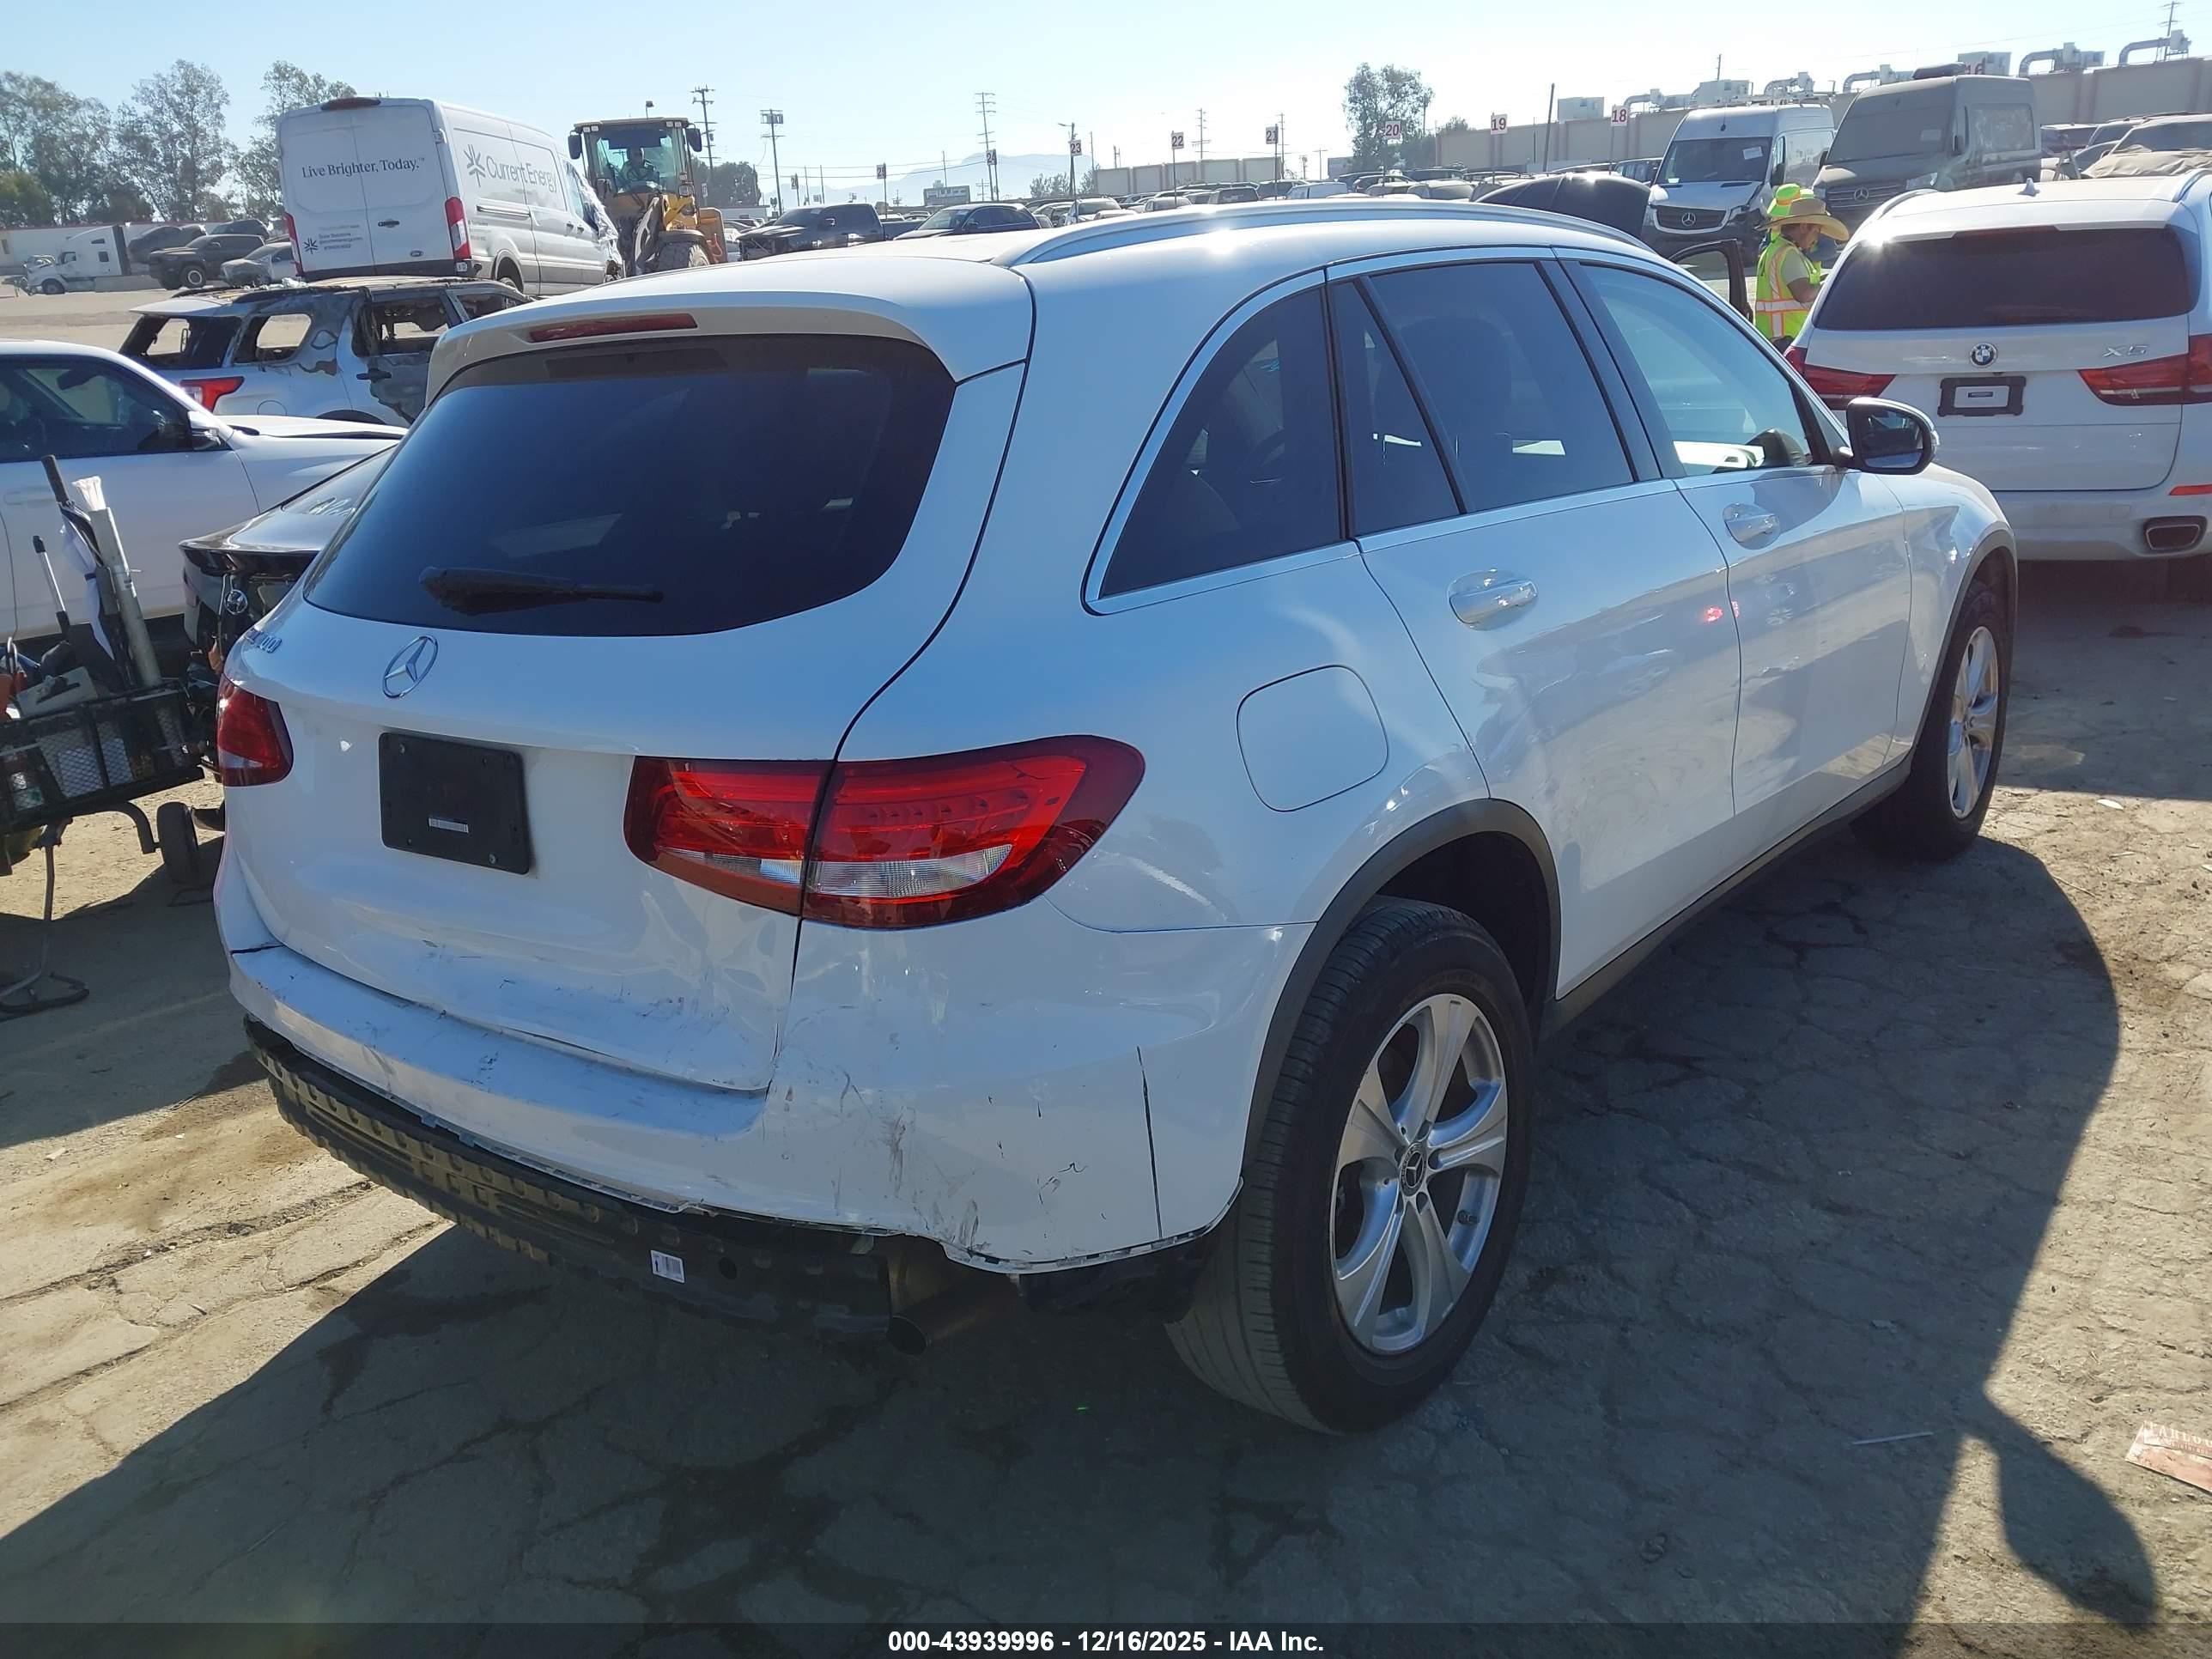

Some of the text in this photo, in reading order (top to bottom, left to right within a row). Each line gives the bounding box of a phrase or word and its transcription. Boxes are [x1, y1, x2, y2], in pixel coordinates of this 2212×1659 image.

[1612, 108, 1626, 122] 18
[1386, 124, 1400, 136] 20
[1492, 117, 1506, 131] 19
[1171, 135, 1183, 147] 22
[1266, 130, 1277, 142] 21
[1070, 143, 1081, 154] 23
[301, 166, 325, 179] Live
[327, 161, 379, 177] Brighter,
[486, 155, 557, 193] Current Energy
